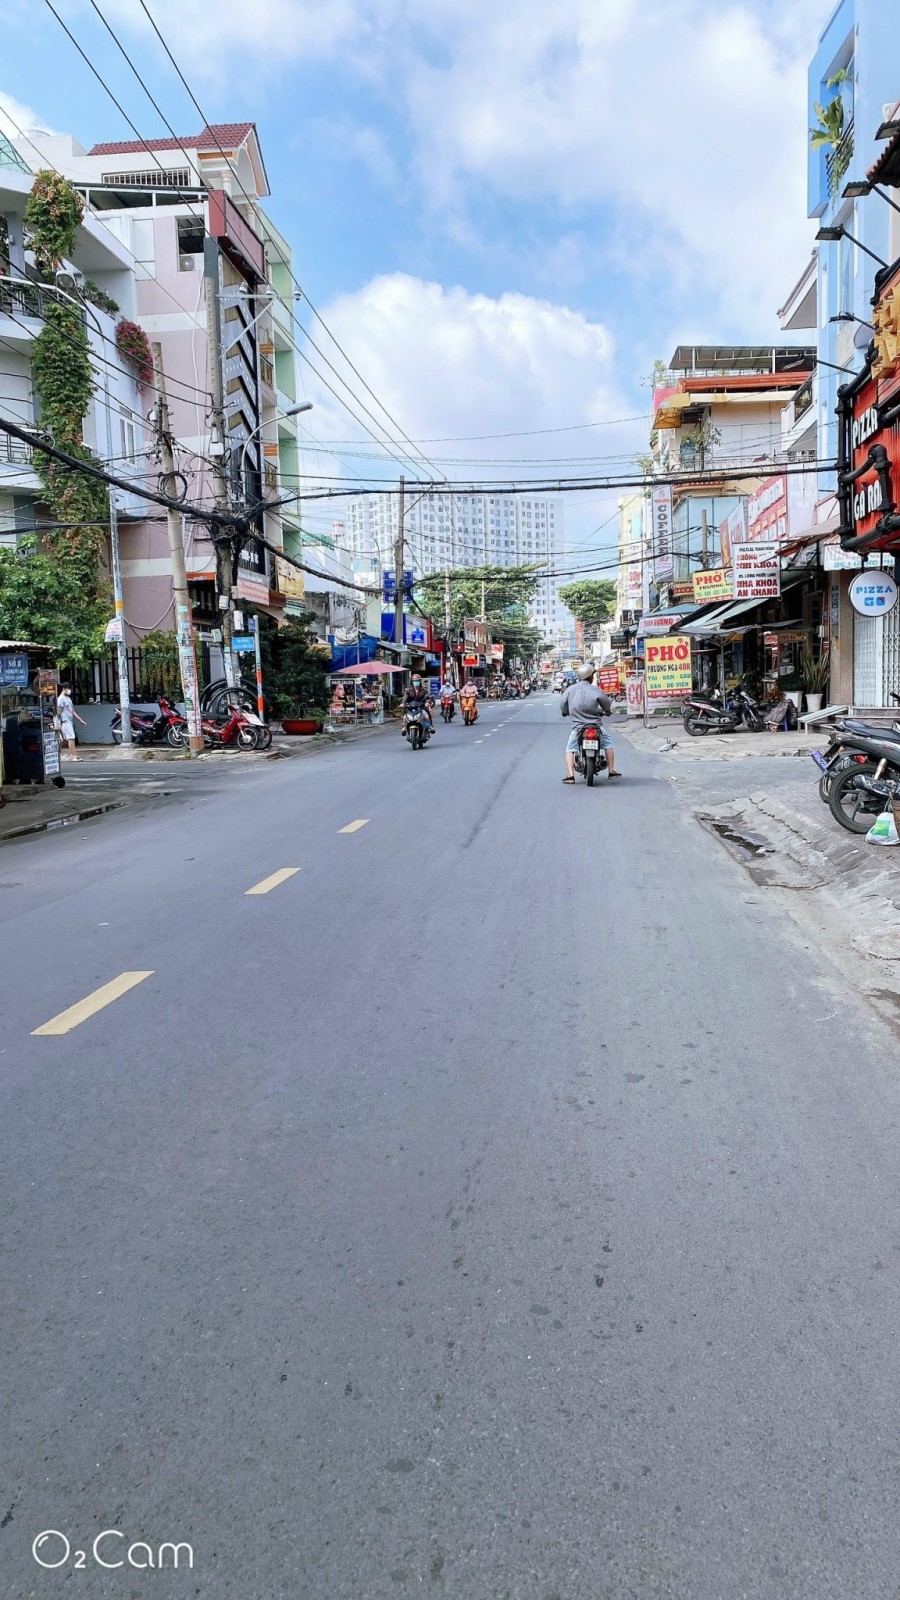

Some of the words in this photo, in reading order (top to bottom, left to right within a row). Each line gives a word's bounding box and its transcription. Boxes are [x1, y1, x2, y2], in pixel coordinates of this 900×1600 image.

[853, 406, 877, 450] PIZZA
[657, 504, 668, 555] COFFEE
[695, 571, 722, 586] PHỞ
[737, 580, 753, 588] NHA
[756, 579, 778, 587] KHOA
[738, 589, 749, 597] AN
[751, 588, 778, 597] KHANG
[856, 586, 893, 594] PIZZA
[647, 638, 689, 661] PHỞ
[668, 664, 679, 672] NGA
[679, 662, 691, 671] 40K
